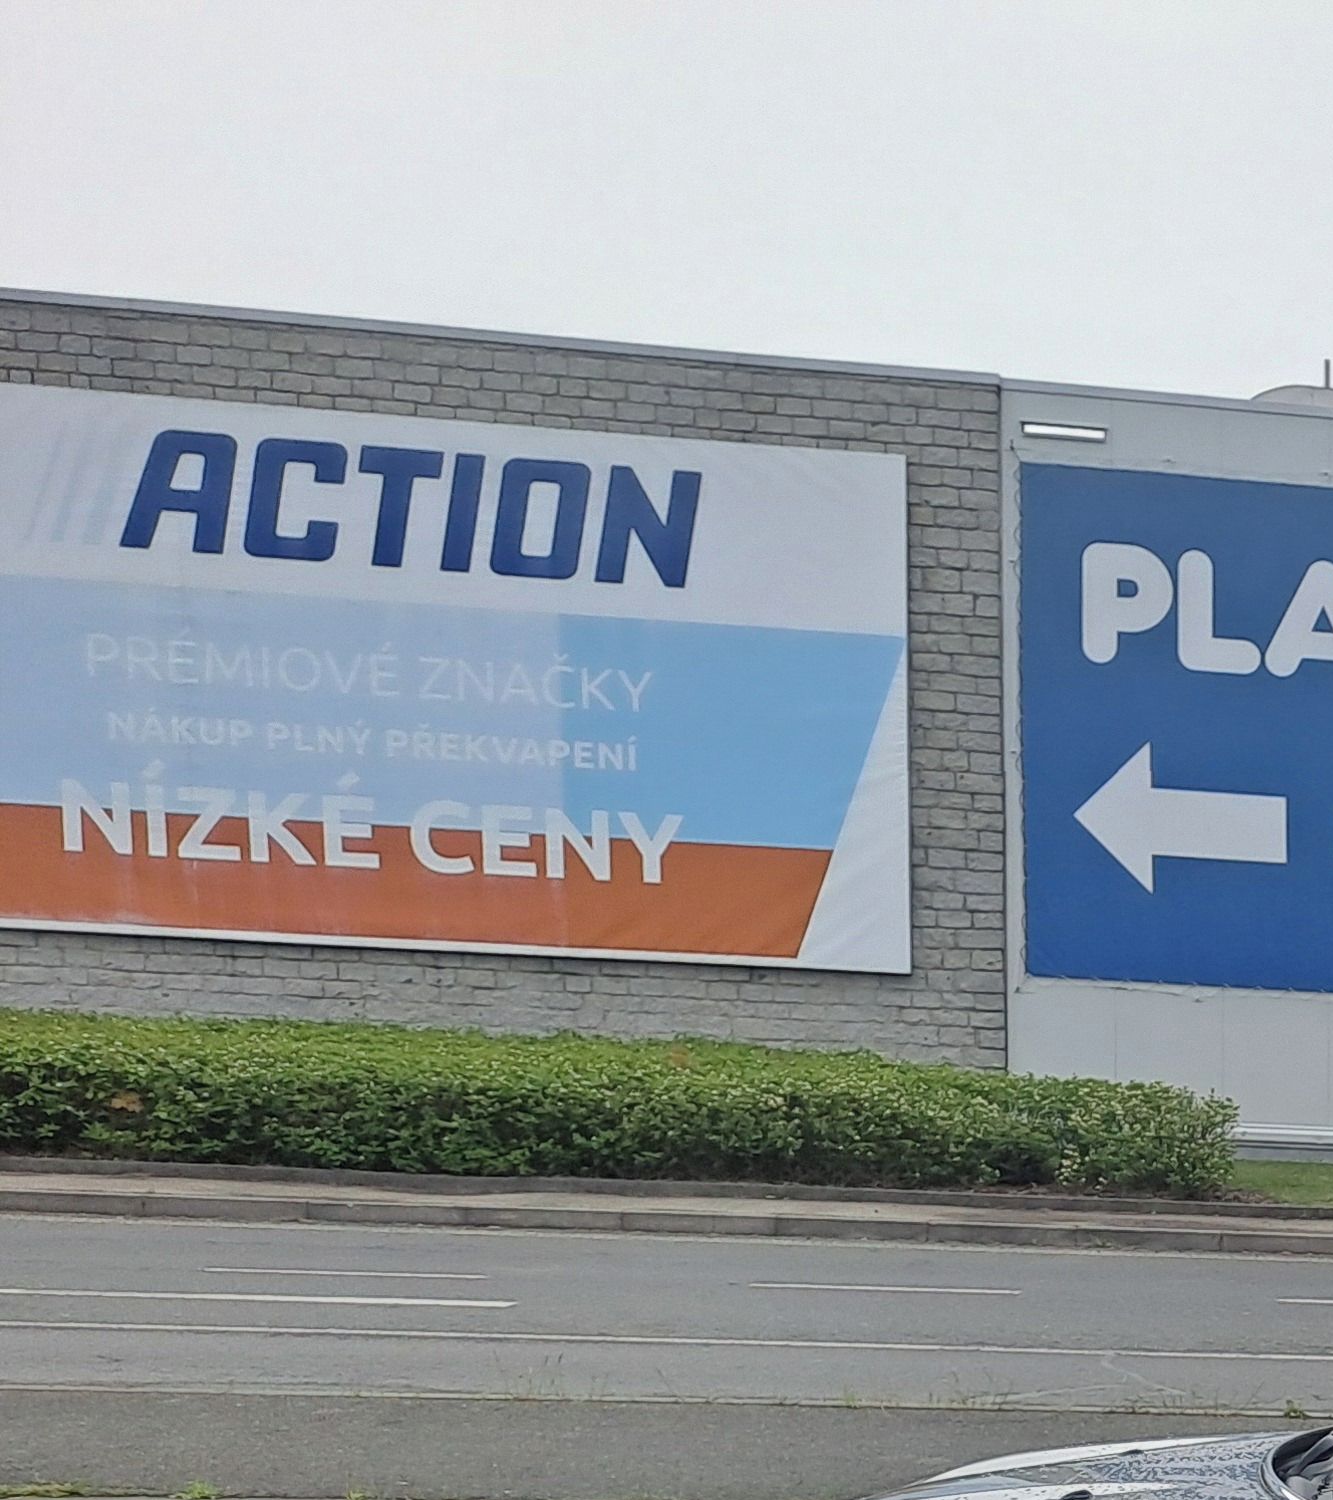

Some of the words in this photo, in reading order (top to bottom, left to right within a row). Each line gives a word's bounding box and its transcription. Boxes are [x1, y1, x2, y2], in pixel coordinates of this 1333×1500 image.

[120, 429, 702, 588] ACTION
[86, 632, 400, 698] PRÉMIOVÉ
[418, 652, 653, 713] ZNAČKY
[107, 707, 254, 748] NÁKUP
[266, 717, 371, 755] PLNÝ
[385, 723, 638, 771] PŘEKVAPENÍ
[60, 758, 380, 870] NÍZKÉ
[409, 799, 684, 884] CENY
